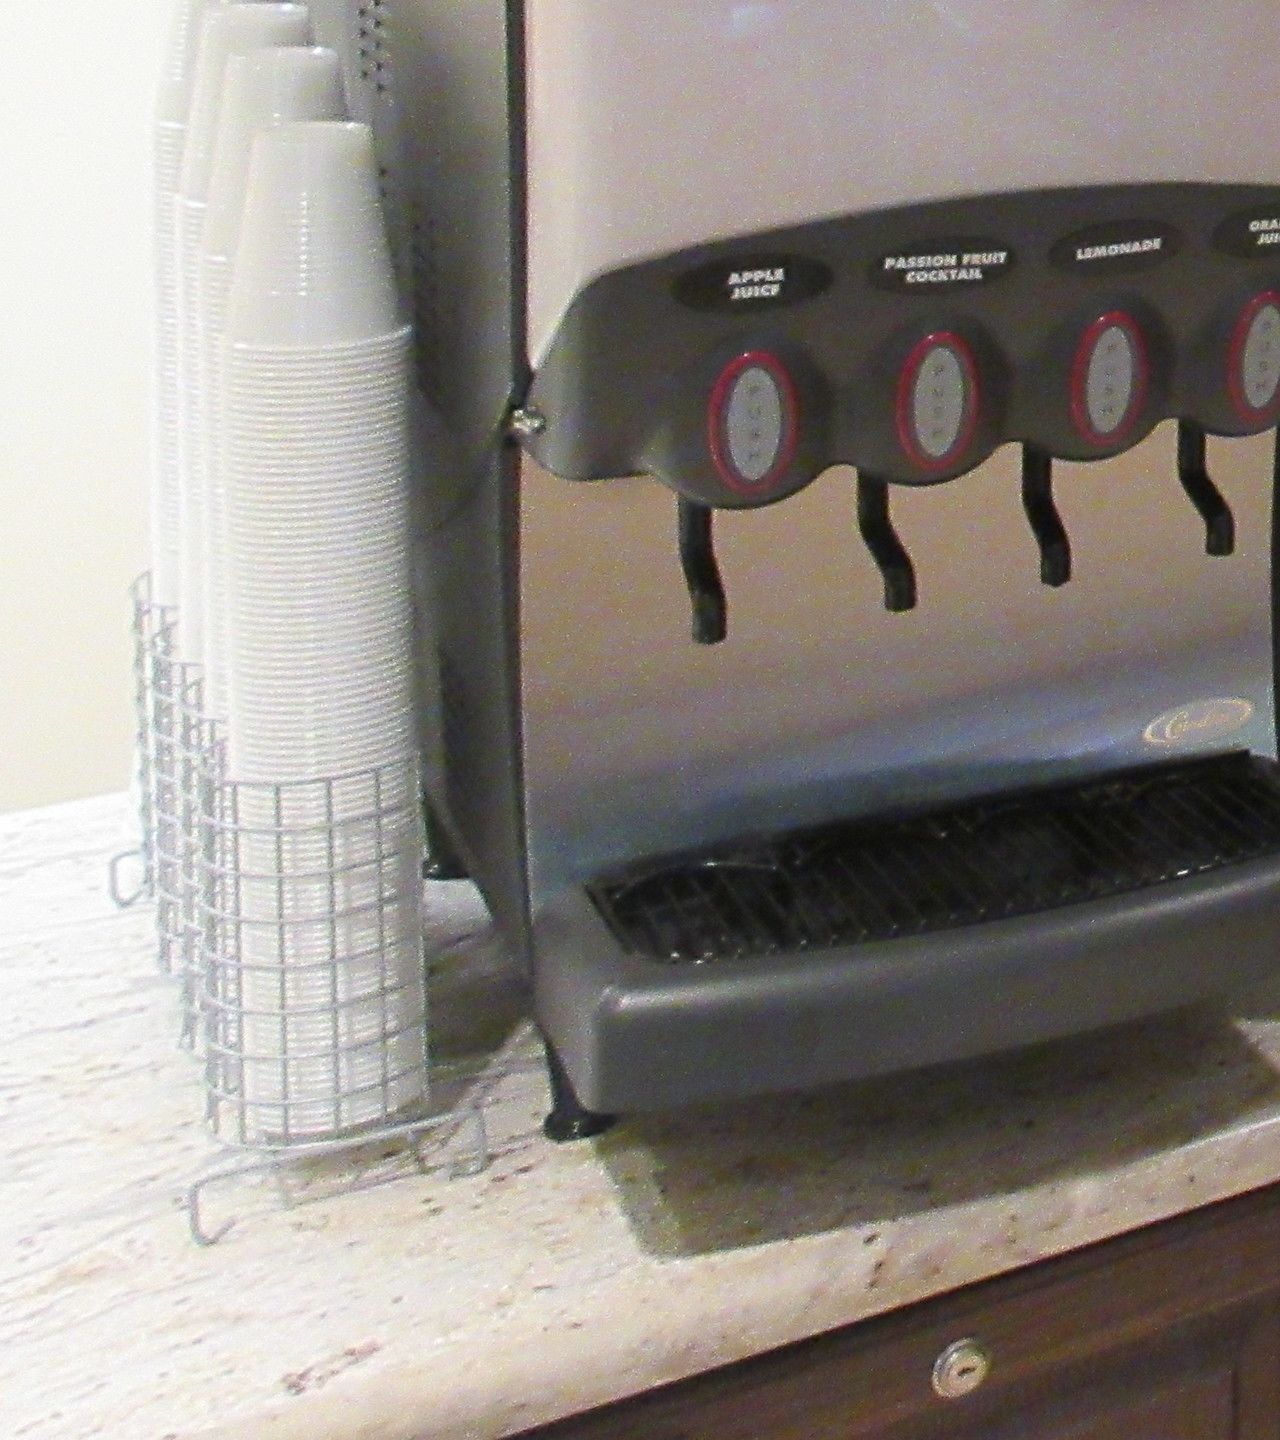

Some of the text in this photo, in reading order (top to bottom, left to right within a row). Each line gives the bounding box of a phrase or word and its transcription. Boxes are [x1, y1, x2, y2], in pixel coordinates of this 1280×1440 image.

[1075, 237, 1163, 260] LEMONADE
[884, 252, 1007, 270] PASSION FRUIT
[728, 268, 785, 285] APPLE
[906, 267, 982, 283] COCKTAIL
[730, 283, 781, 300] JUICE
